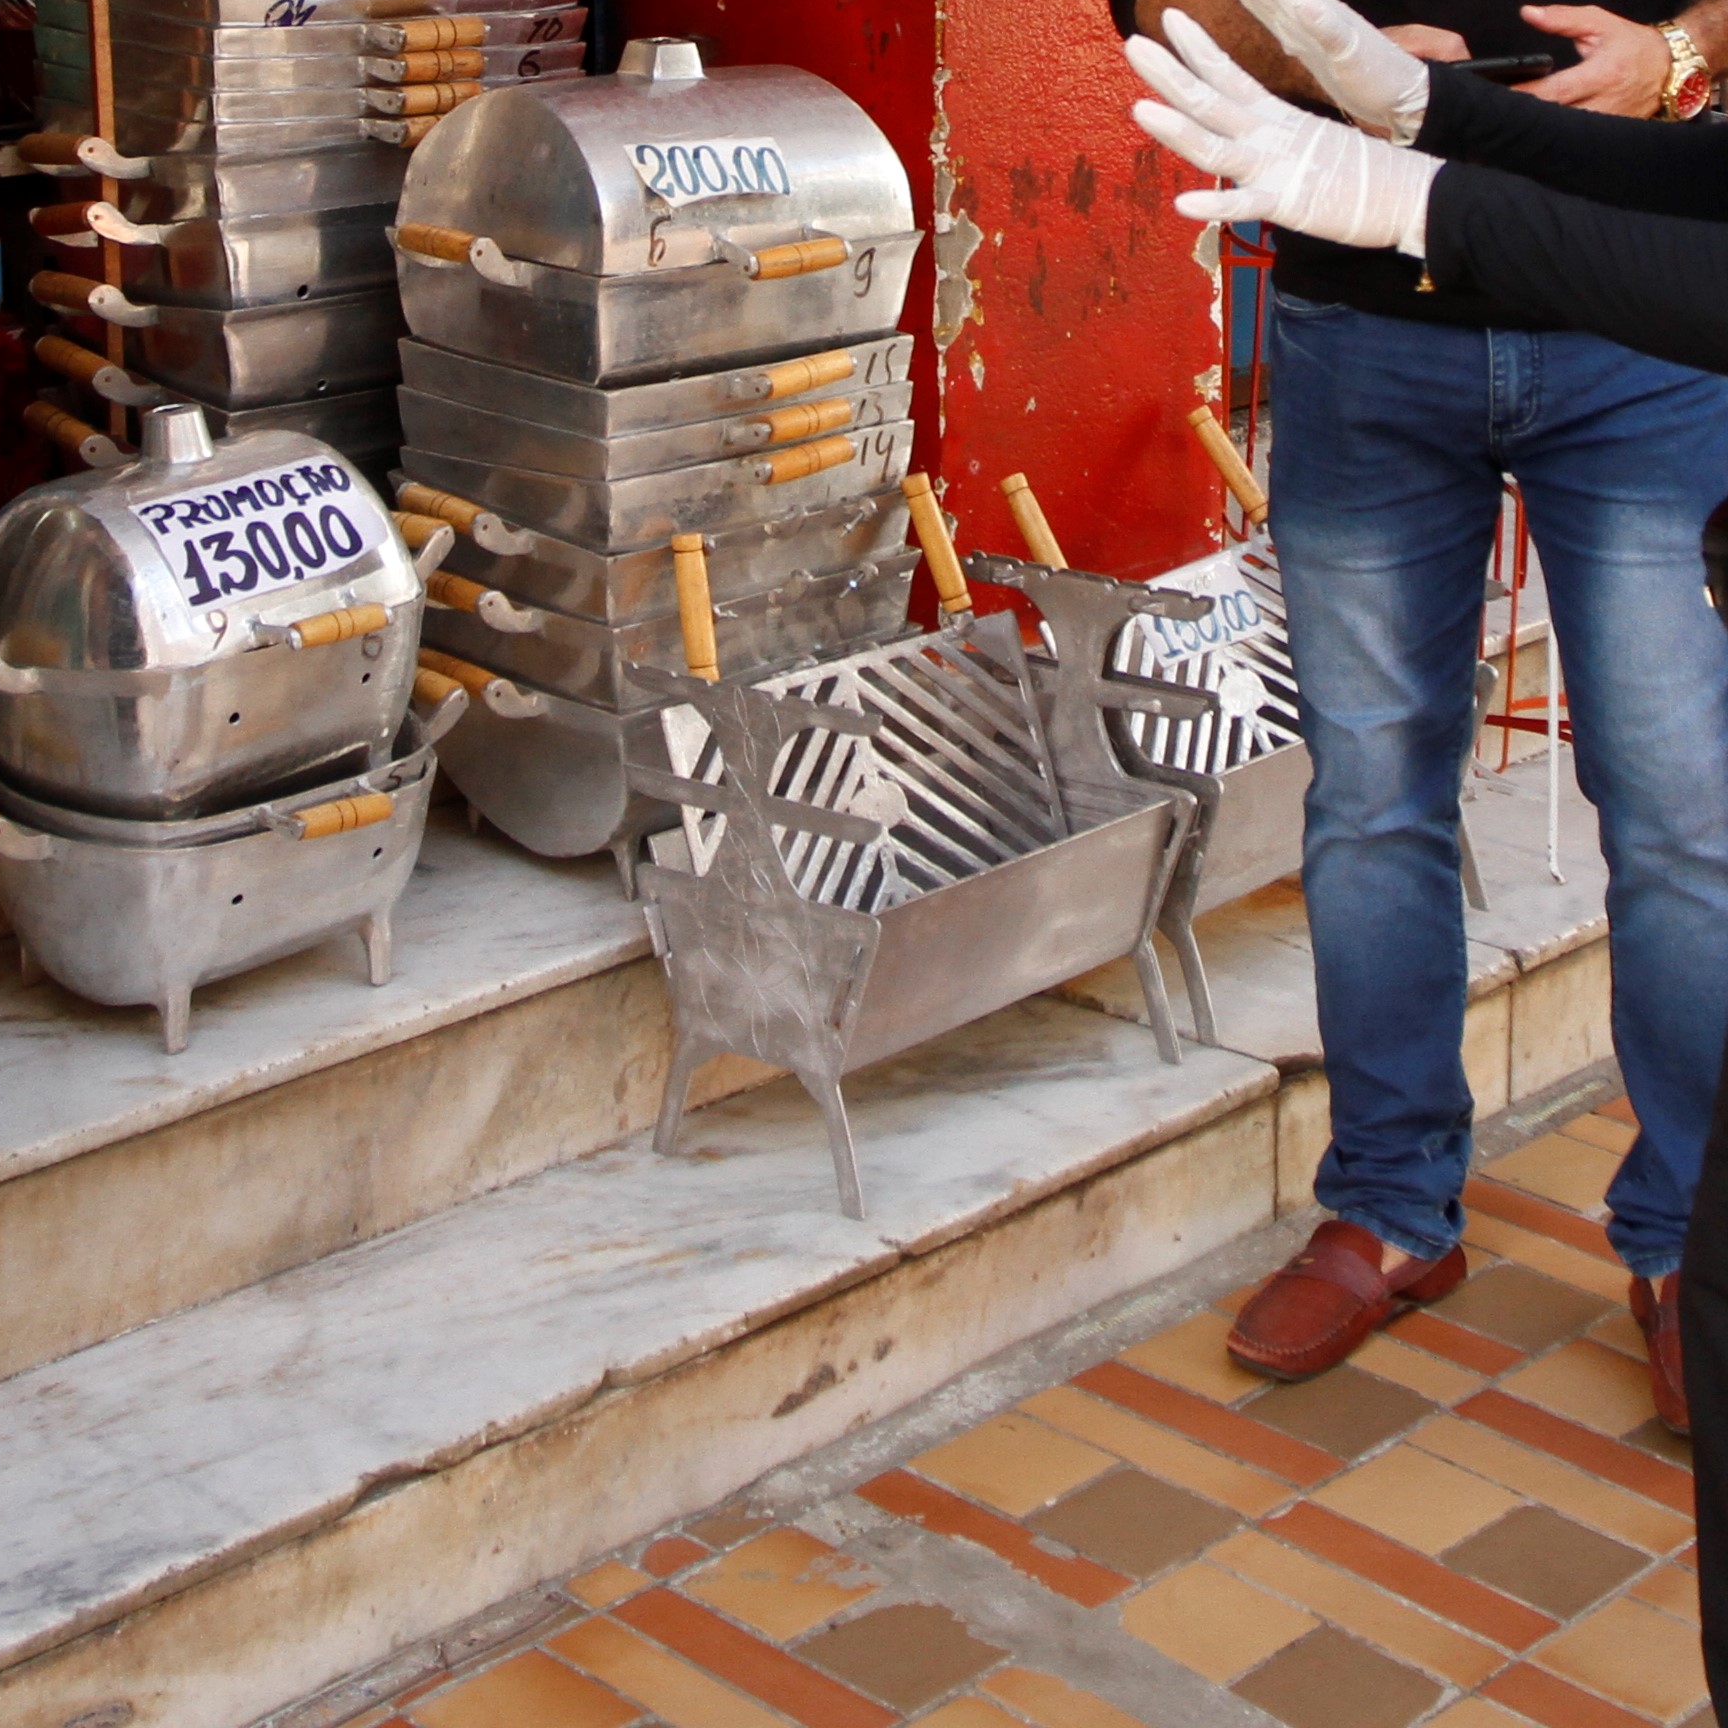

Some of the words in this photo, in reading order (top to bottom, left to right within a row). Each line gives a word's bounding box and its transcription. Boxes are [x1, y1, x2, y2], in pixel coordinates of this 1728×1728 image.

[518, 49, 541, 77] 6
[635, 143, 791, 199] 200,00
[861, 429, 895, 483] 14
[139, 463, 351, 535] PROMOÇÃO
[183, 504, 364, 607] 130,00
